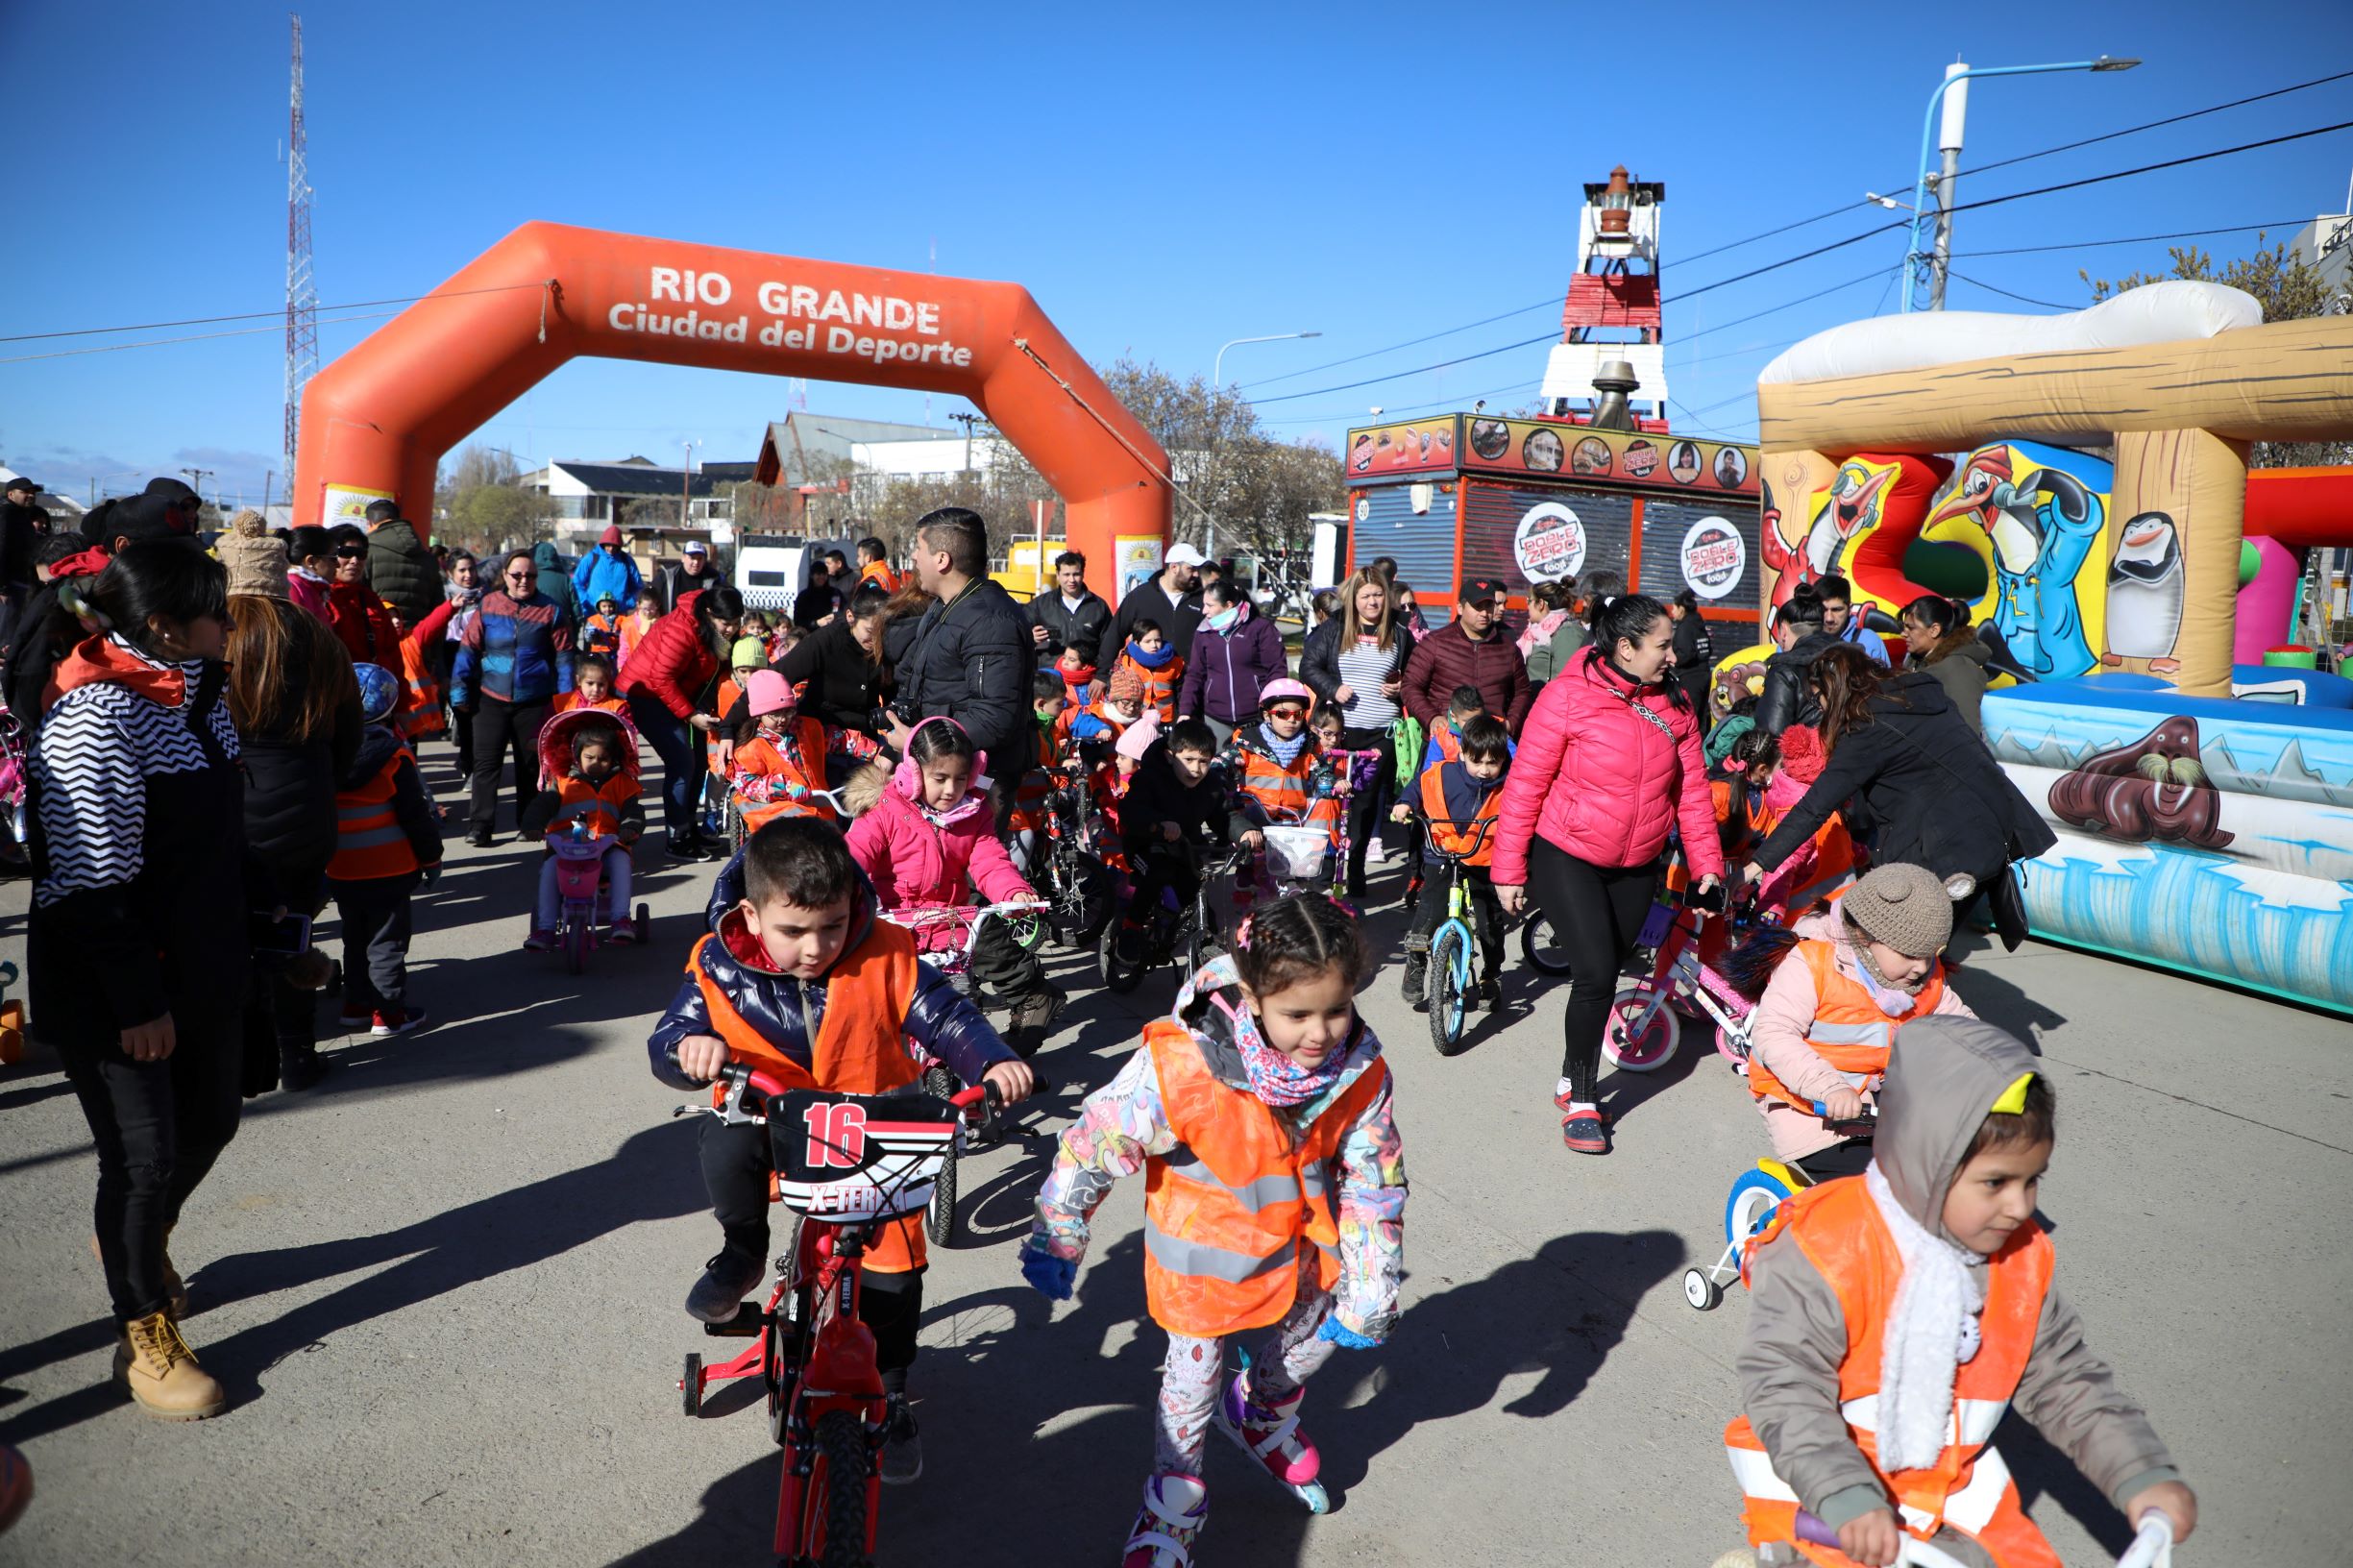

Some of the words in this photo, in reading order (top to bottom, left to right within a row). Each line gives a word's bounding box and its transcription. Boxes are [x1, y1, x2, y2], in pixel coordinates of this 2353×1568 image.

[650, 266, 732, 306] RIO
[757, 282, 940, 335] GRANDE
[608, 303, 748, 343] Ciudad
[759, 319, 817, 351] del
[827, 327, 973, 368] Deporte
[1524, 527, 1575, 552] DOBLE
[1527, 538, 1579, 565] ZERO
[1690, 540, 1736, 563] DOBLE
[1543, 560, 1567, 574] food
[1692, 551, 1737, 575] ZERO
[1705, 571, 1727, 584] food
[803, 1102, 867, 1168] 16
[806, 1185, 907, 1213] X-TERRA
[842, 1276, 851, 1309] X-TERRA
